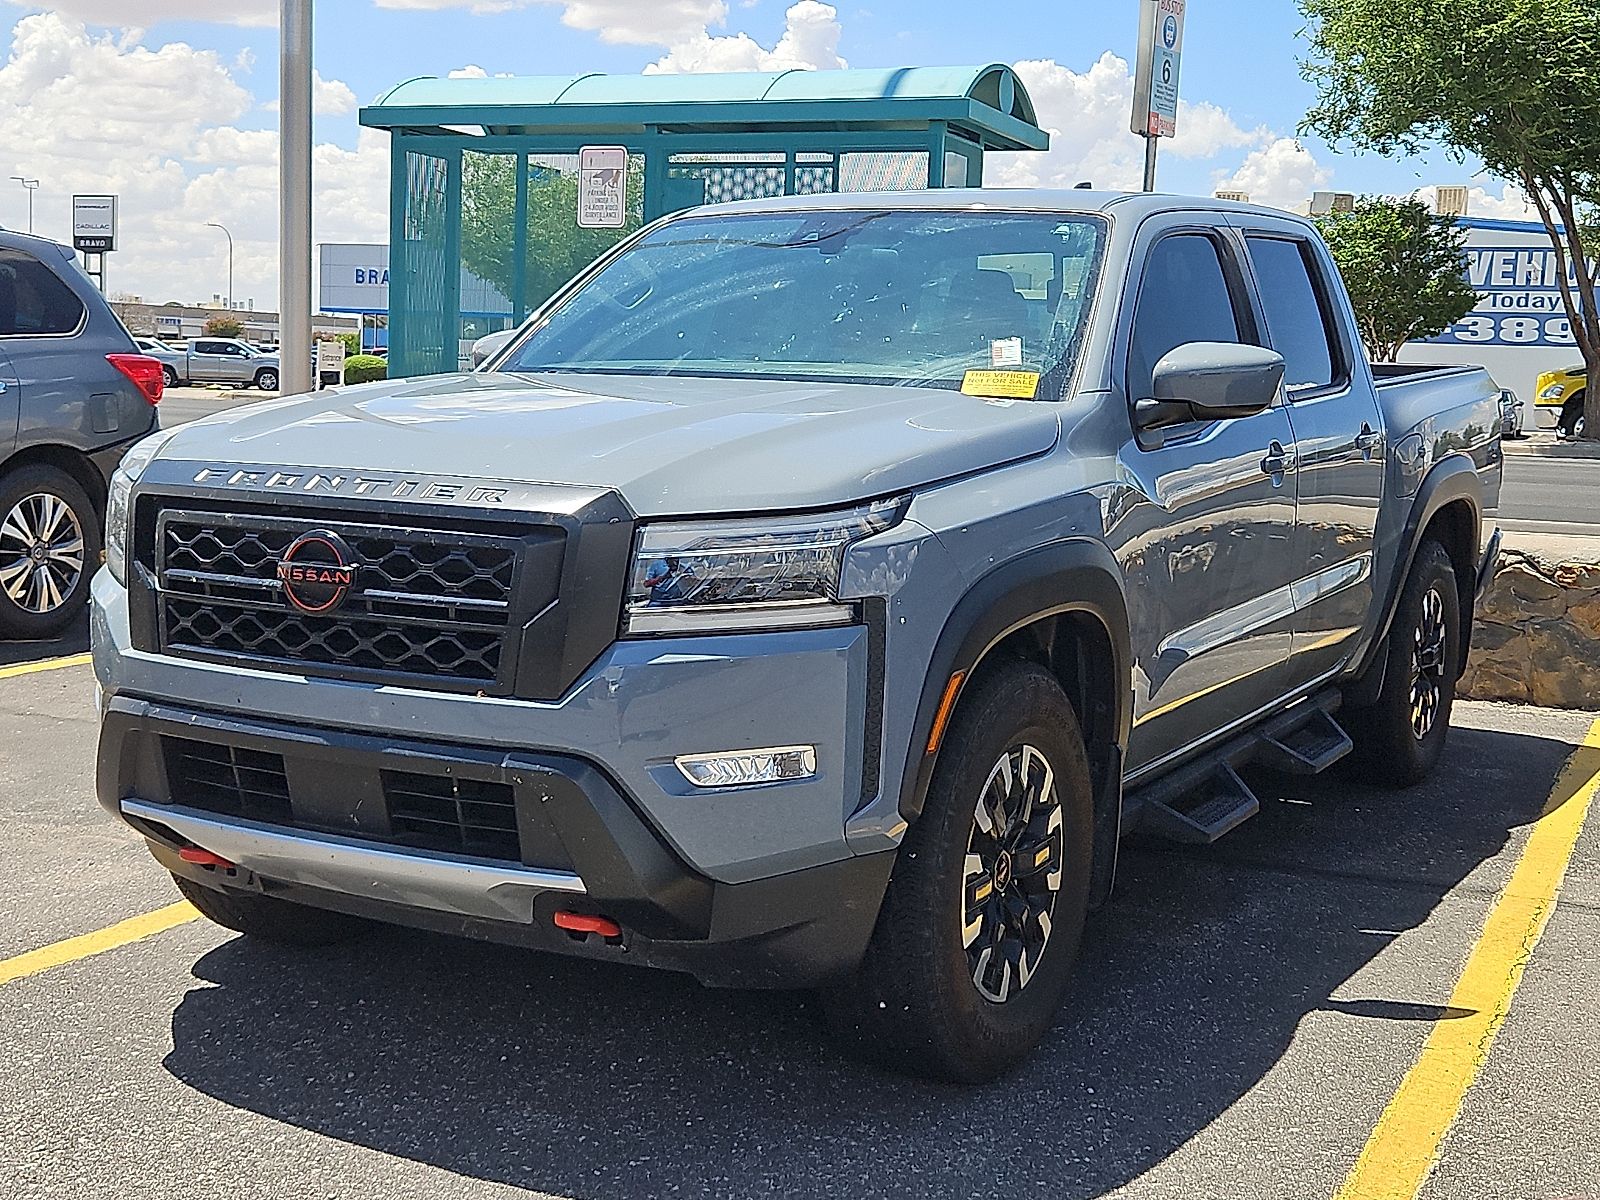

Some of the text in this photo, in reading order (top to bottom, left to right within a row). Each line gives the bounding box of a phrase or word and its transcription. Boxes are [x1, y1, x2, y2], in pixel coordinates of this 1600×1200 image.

[1160, 0, 1184, 15] BUS STOP
[1162, 59, 1171, 84] 6
[80, 239, 106, 247] BRAVO
[1490, 292, 1561, 311] Today
[321, 353, 342, 362] Entrance
[193, 467, 511, 504] FRONTIER
[276, 566, 351, 586] NISSAN
